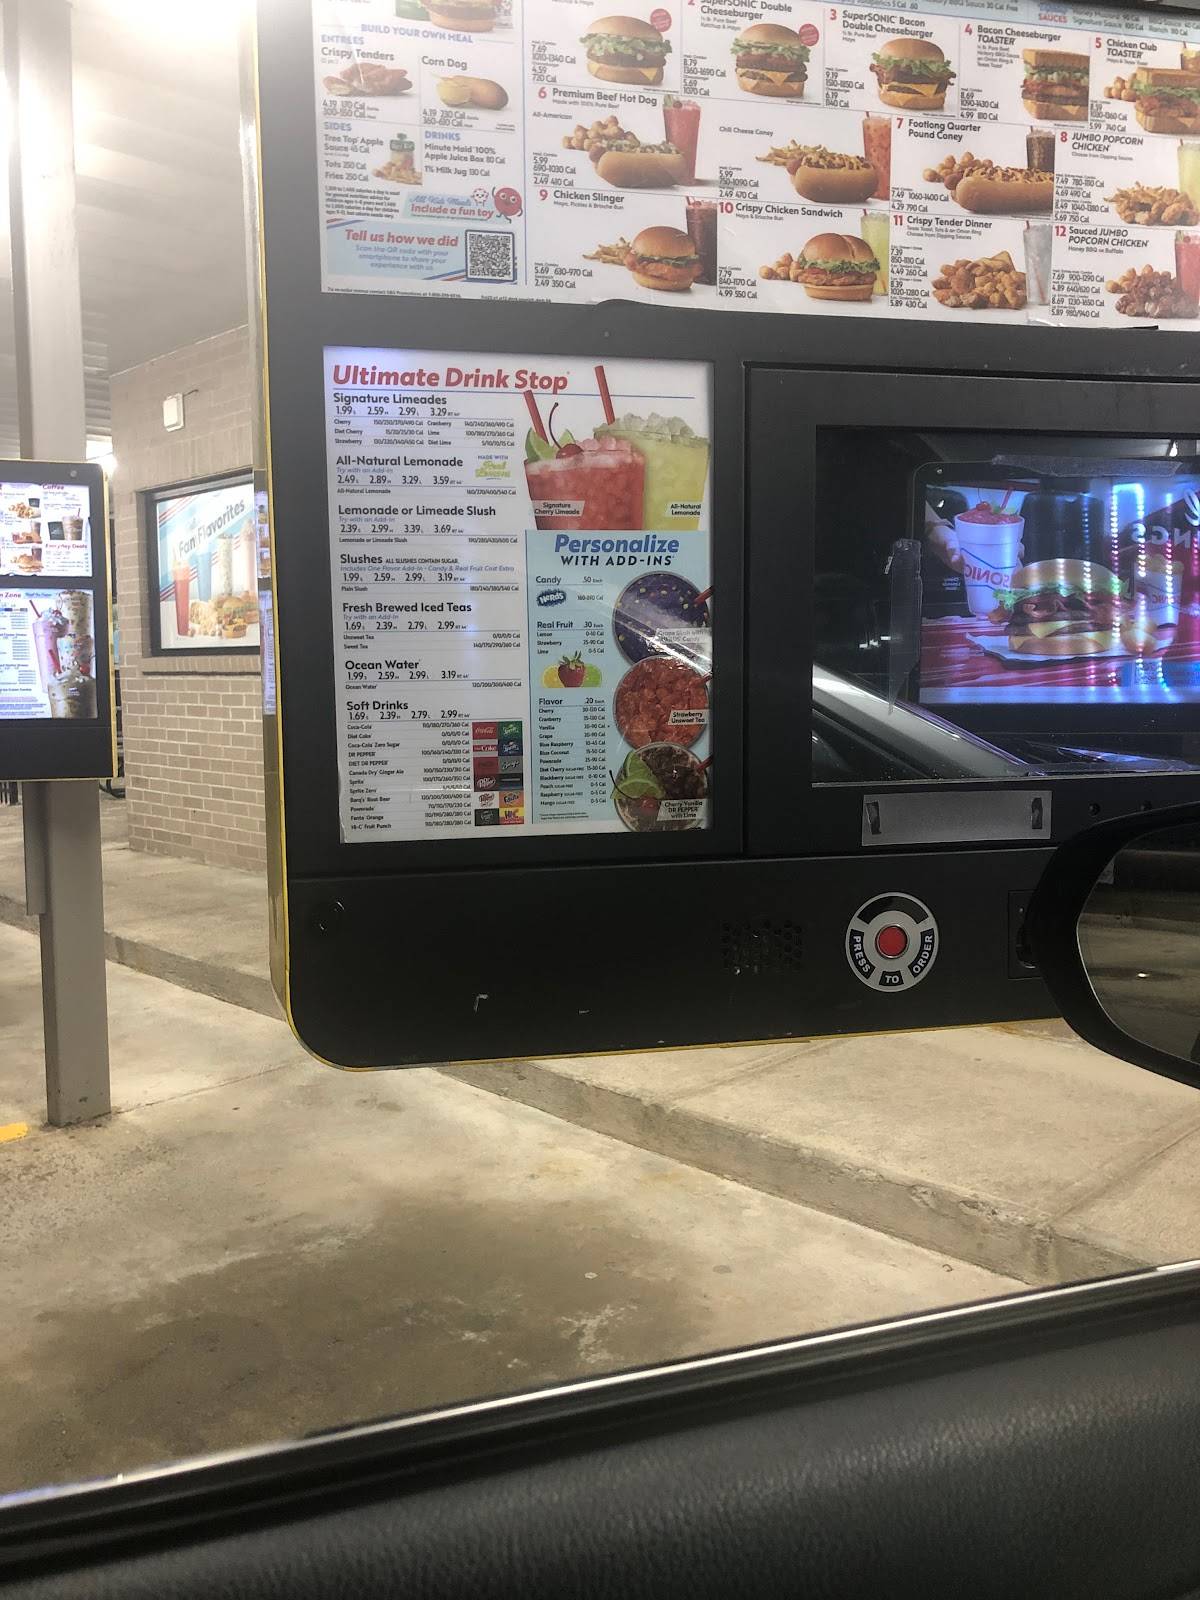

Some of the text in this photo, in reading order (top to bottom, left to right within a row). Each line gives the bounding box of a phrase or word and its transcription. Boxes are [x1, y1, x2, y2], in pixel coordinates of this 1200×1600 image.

[701, 6, 763, 20] Cheeseburger
[830, 9, 925, 27] 3 SuperSONIC Bacon
[362, 24, 390, 34] BUILD
[393, 27, 419, 37] YOUR
[422, 30, 446, 40] OWN
[843, 20, 873, 31] Double
[875, 25, 933, 38] Cheeseburger
[965, 24, 1061, 41] 4 Bacon Cheeseburger
[1096, 38, 1157, 51] 5 Chicken Club
[321, 47, 394, 61] Crispy Tenders
[422, 56, 467, 70] Corn Dog
[539, 87, 657, 106] 6 Premium Beef Hot Dog
[897, 118, 980, 132] 7 Footlong Quarter
[425, 130, 460, 141] DRINKS
[909, 129, 963, 141] Pound Coney
[1061, 132, 1143, 145] 8 JUMBO POPCORN
[1072, 142, 1108, 152] CHICKEN
[540, 190, 624, 202] 9 Chicken Slinger
[411, 204, 450, 214] Include
[452, 207, 457, 215] a
[459, 207, 475, 216] fun
[478, 209, 494, 220] toy
[719, 202, 843, 218] 10 Crispy Chicken Sandwich
[893, 215, 992, 229] 11 Crispy Tender Dinner
[345, 229, 458, 246] Tell us how we did
[1055, 226, 1128, 237] 12 Sauced JUMBO
[1069, 236, 1148, 247] POPCORN CHICKEN
[333, 365, 568, 395] Ultimate Drink Stop
[334, 393, 446, 405] Signature Limeades
[336, 406, 446, 416] 1.99 2.59 2.99 3.29
[336, 456, 463, 467] All-Natural Lemonade
[402, 476, 418, 484] 3.29
[433, 476, 449, 484] 3.59
[338, 505, 496, 516] Lemonade or Limeade Slush
[179, 500, 245, 558] Fan Flavorites
[341, 525, 451, 533] 2.39 2.99 3.39 3.69
[555, 534, 679, 553] Personalize
[340, 554, 382, 564] Slushes
[561, 556, 672, 565] WITH ADD-INS
[344, 573, 453, 581] 1.99 2.59 2.99 3.19
[536, 576, 561, 585] Candy
[343, 603, 471, 612] Fresh Brewed Iced Teas
[345, 622, 361, 630] 1.69
[345, 660, 419, 670] Ocean Water
[348, 672, 364, 680] 1.99
[378, 672, 394, 680] 2.59
[441, 671, 456, 679] 3.19
[347, 701, 408, 711] Soft Drinks
[350, 710, 457, 720] 1.69 2.39 2.79 2.99
[853, 935, 932, 983] PRESS TO ORDER
